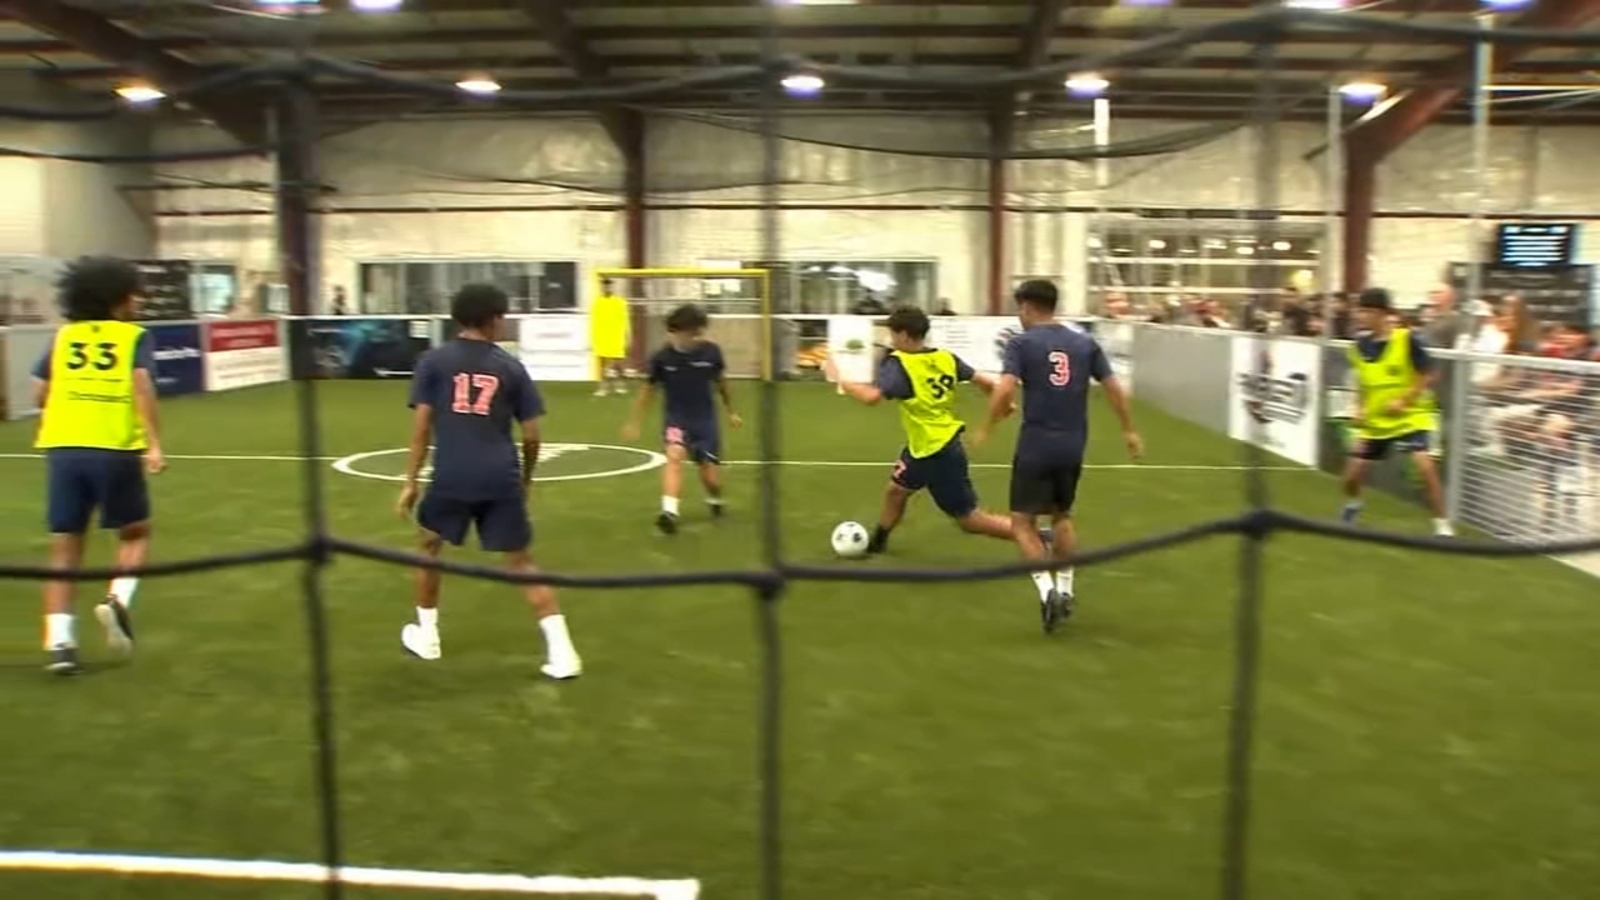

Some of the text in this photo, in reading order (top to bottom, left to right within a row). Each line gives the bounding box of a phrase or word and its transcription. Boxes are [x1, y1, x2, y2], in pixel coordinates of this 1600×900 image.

[66, 342, 118, 371] 33
[1048, 351, 1070, 386] 3
[451, 372, 500, 416] 17
